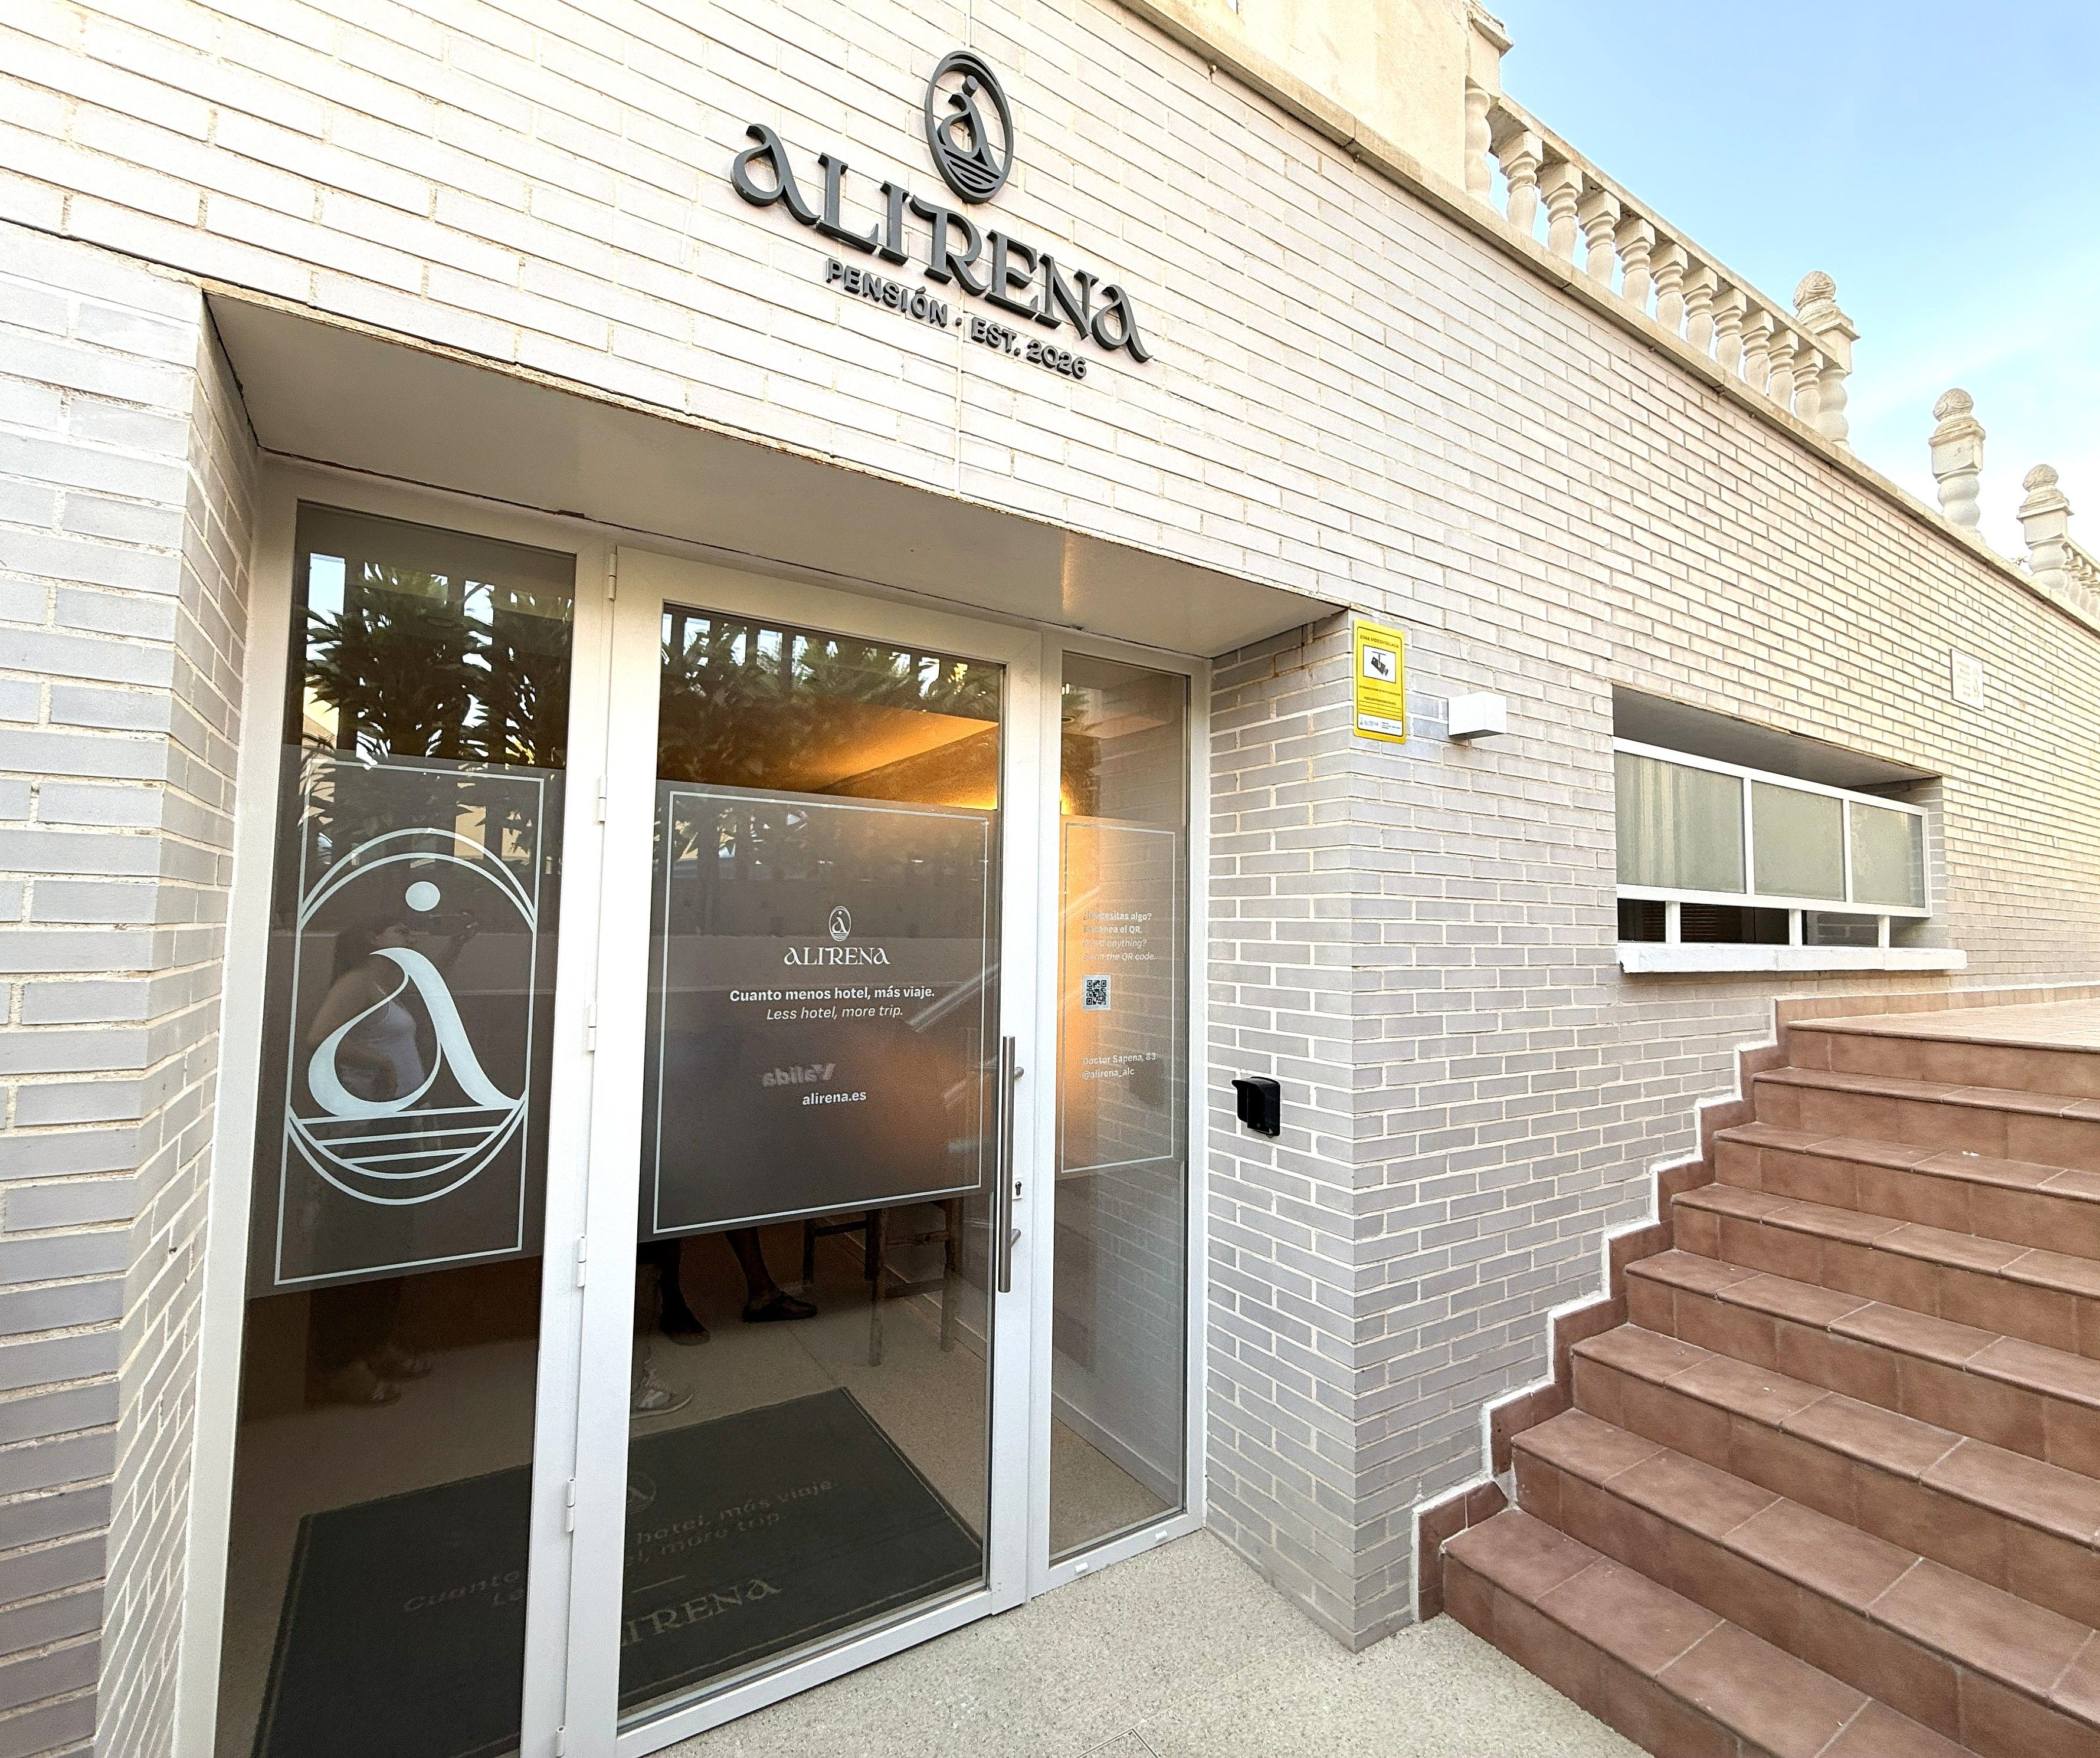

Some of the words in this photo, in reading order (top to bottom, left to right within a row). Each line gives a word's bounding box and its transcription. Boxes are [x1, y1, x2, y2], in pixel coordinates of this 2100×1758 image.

[826, 257, 948, 327] PENSIÓN
[971, 316, 1021, 356] EST.
[1027, 339, 1087, 380] 2026
[1131, 911, 1152, 922] algo?
[1120, 924, 1128, 933] el
[1129, 925, 1143, 934] QR.
[1107, 939, 1147, 949] anything?
[1106, 952, 1121, 961] the
[1122, 953, 1134, 962] QR
[1135, 952, 1157, 960] code.
[730, 990, 782, 1002] Cuanto
[785, 989, 831, 1001] menos
[834, 986, 871, 1000] hotel,
[874, 985, 900, 998] más
[903, 986, 935, 998] viaje.
[767, 1009, 797, 1020] Less
[801, 1006, 837, 1020] hotel,
[841, 1007, 876, 1018] more
[880, 1005, 903, 1018] trip.
[1082, 1056, 1110, 1065] Doctor
[1112, 1054, 1144, 1064] Sapena,
[1082, 1067, 1135, 1080] @alirena_alc
[802, 1090, 867, 1106] alirena.es
[404, 1570, 520, 1612] Cuanto
